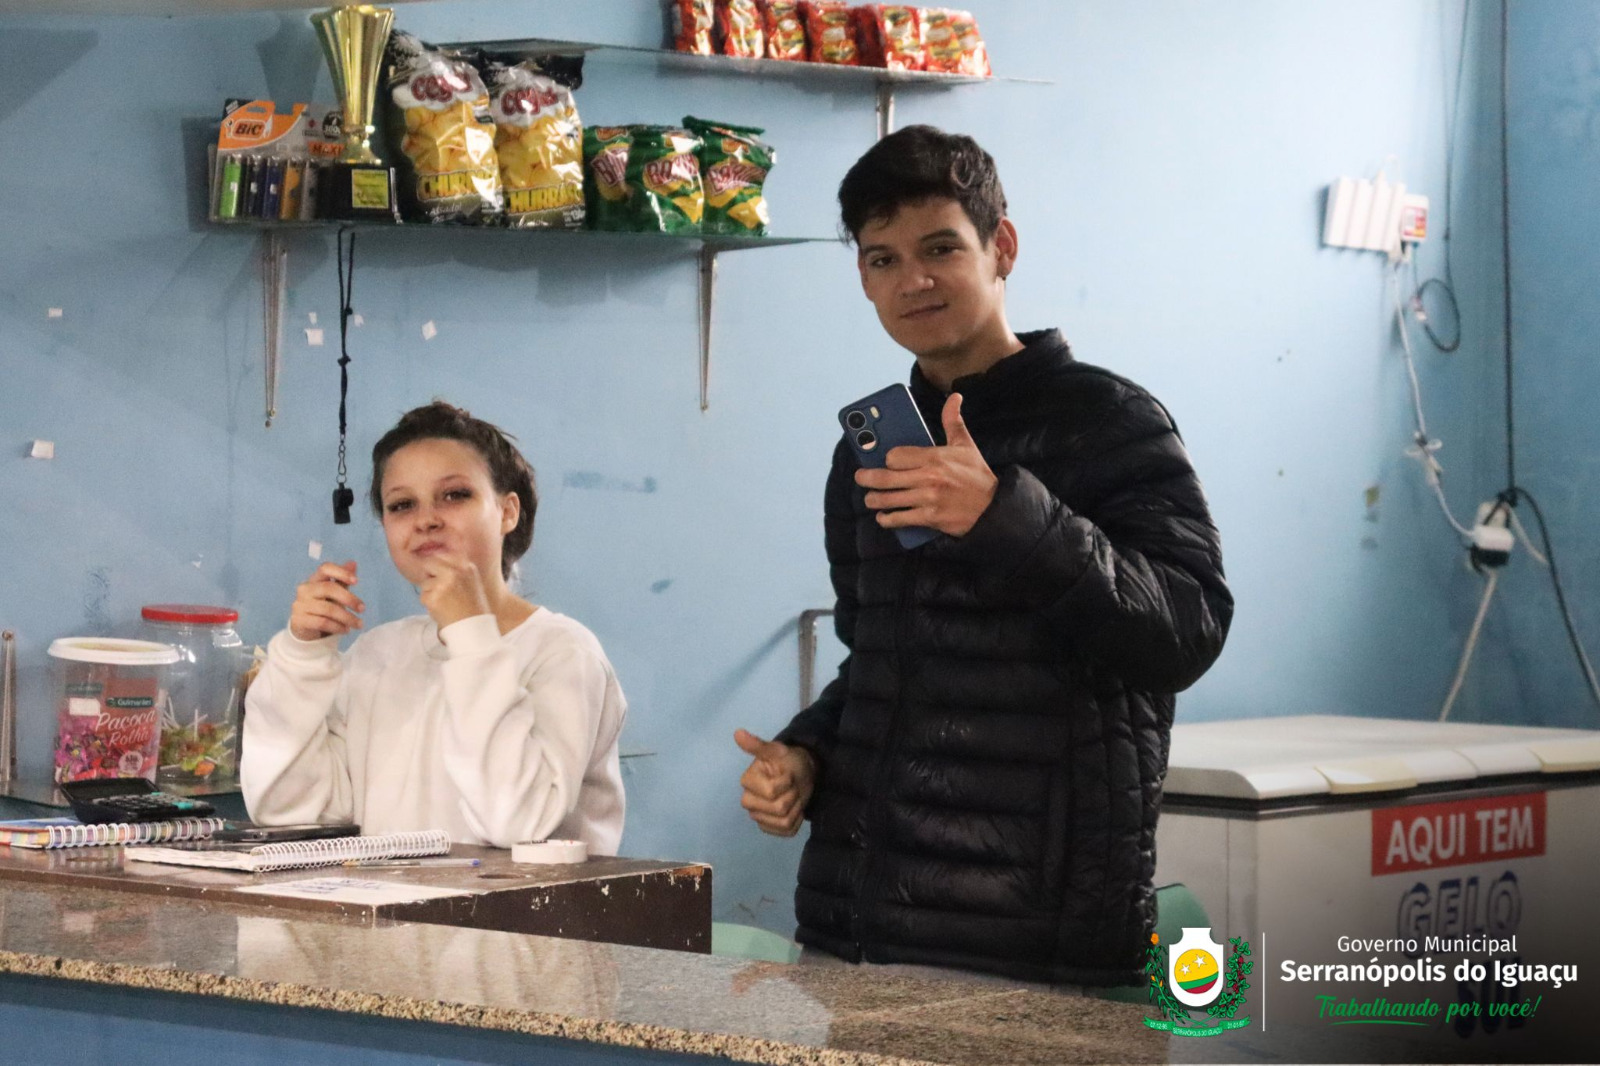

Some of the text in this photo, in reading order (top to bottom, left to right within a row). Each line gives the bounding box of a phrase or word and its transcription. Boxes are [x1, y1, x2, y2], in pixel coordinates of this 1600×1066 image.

[1385, 805, 1534, 865] AQUI TEM
[1396, 870, 1522, 959] GELO
